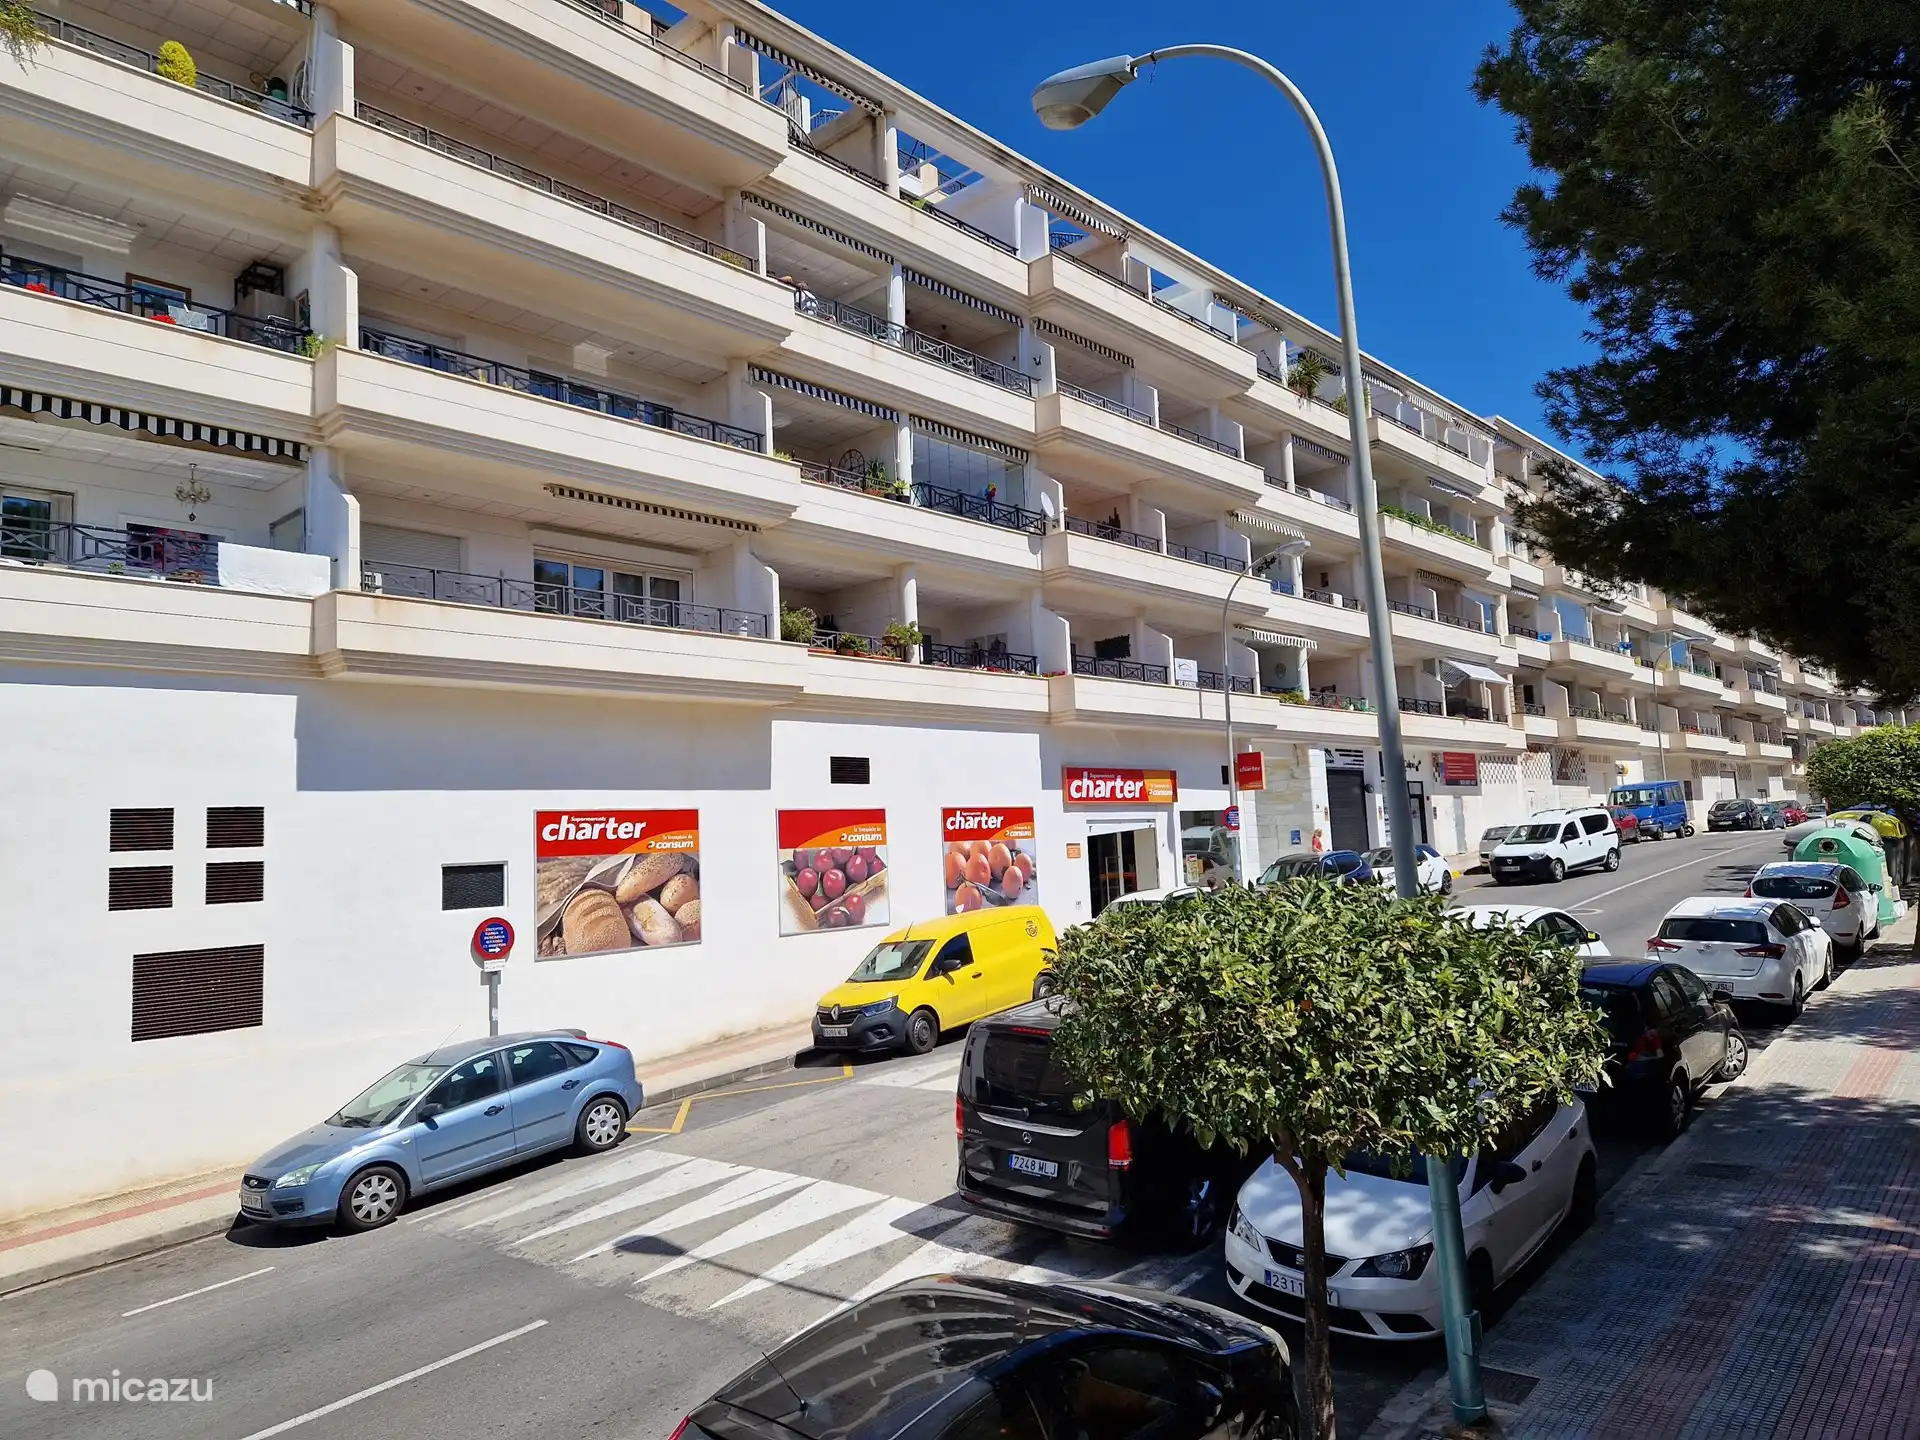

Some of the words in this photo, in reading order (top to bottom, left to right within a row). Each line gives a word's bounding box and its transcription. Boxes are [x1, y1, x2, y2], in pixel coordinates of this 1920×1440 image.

[1070, 771, 1143, 798] charter
[541, 815, 646, 841] charter
[946, 810, 1004, 830] charter
[656, 841, 693, 849] consum
[848, 833, 882, 842] consum
[1014, 1156, 1036, 1171] 7248
[1038, 1162, 1056, 1175] MLJ
[1273, 1274, 1303, 1295] 2311
